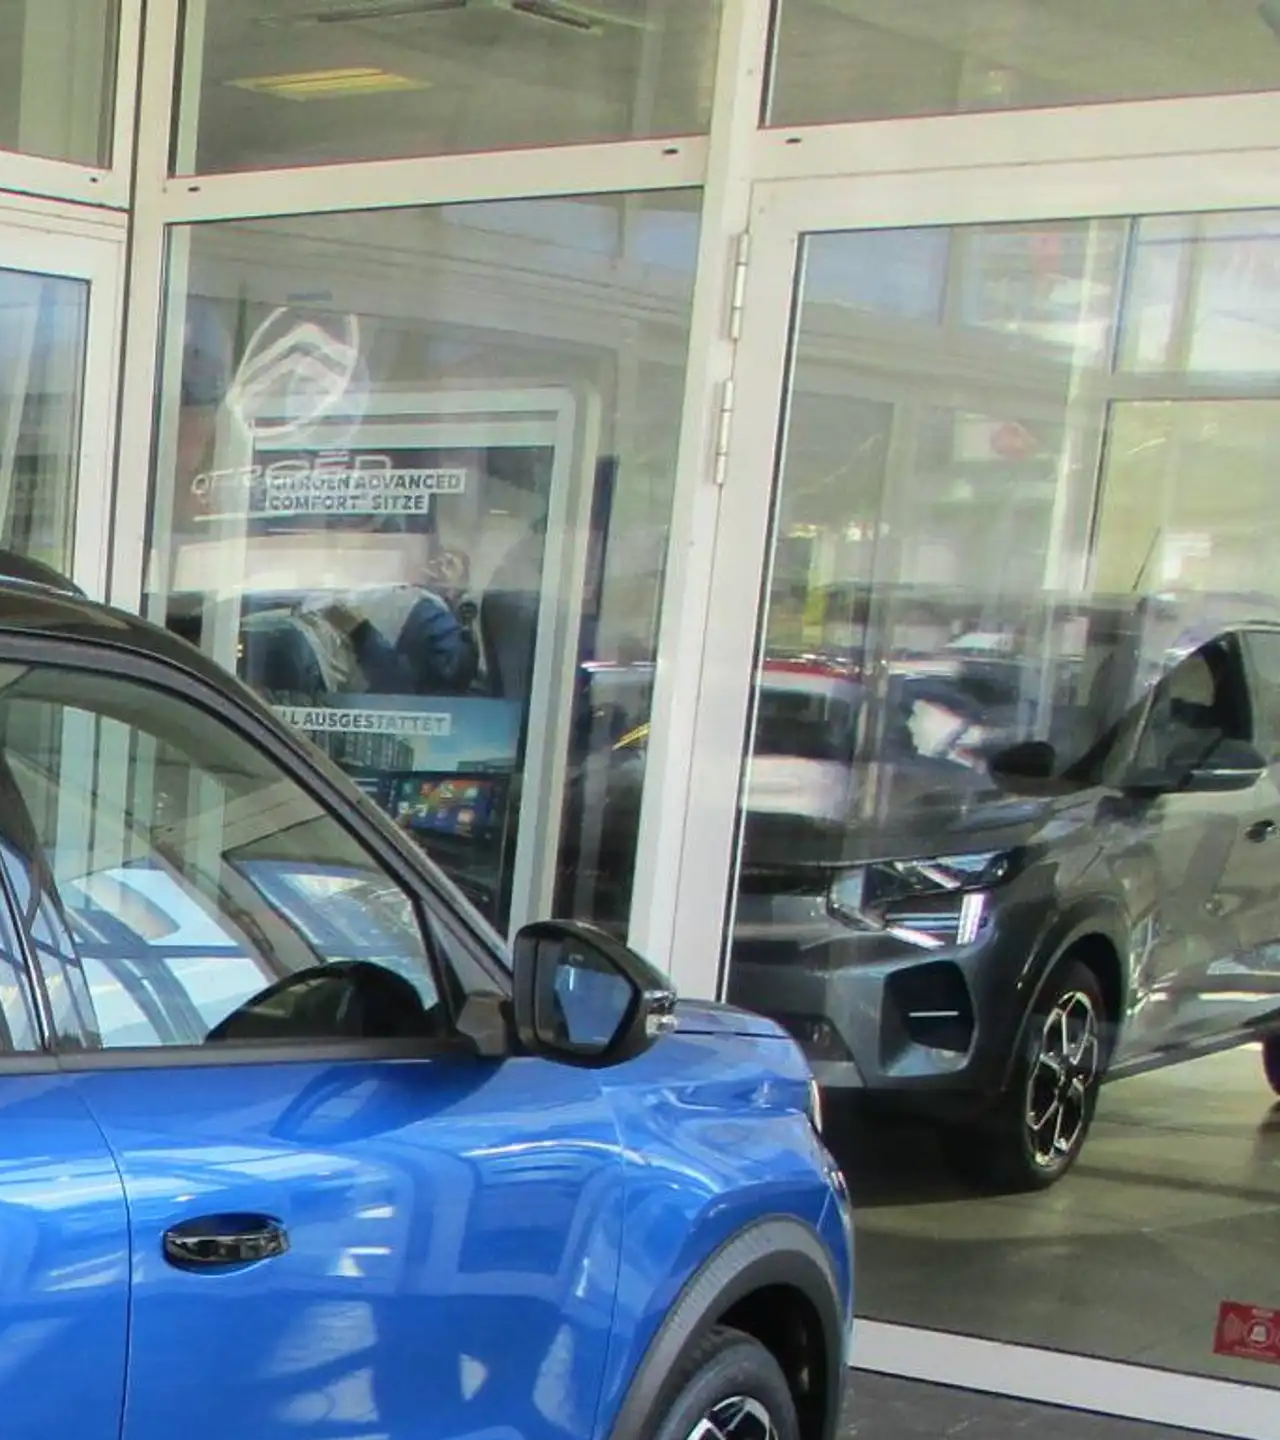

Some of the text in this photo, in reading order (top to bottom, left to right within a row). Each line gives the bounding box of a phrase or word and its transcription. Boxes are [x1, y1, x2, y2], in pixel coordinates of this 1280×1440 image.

[357, 474, 462, 491] ADVANCED
[372, 495, 426, 511] SITZE
[303, 711, 447, 733] AUSGESTATTET
